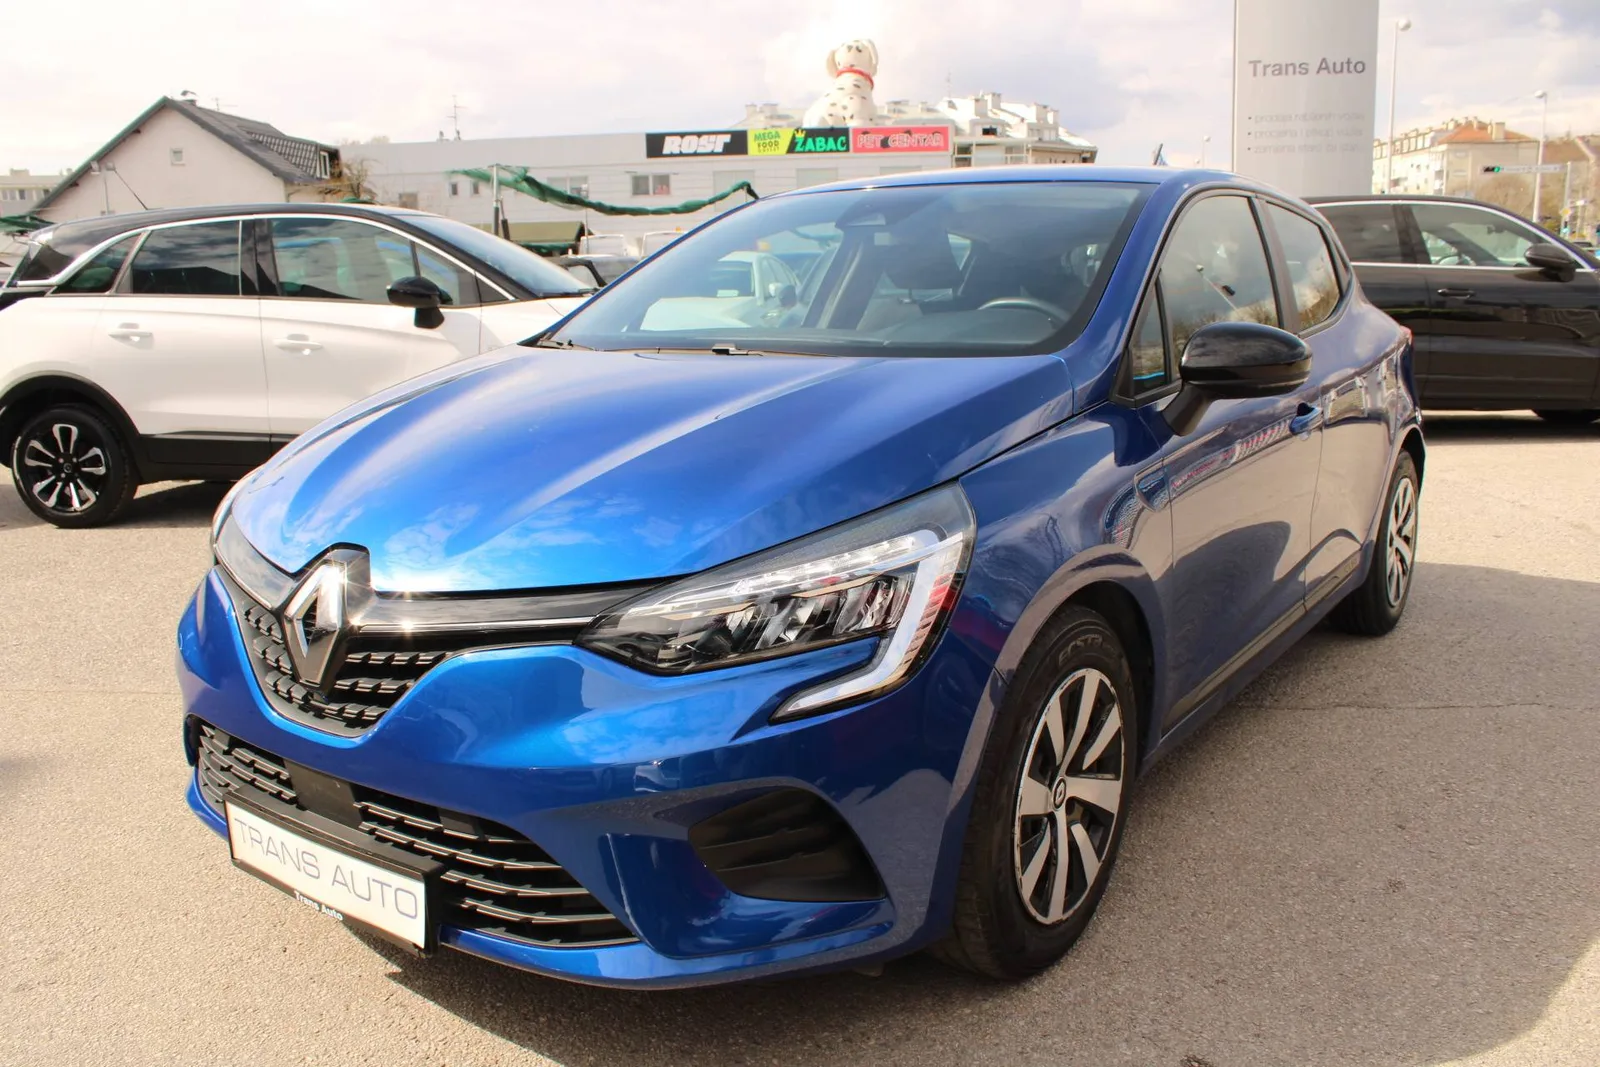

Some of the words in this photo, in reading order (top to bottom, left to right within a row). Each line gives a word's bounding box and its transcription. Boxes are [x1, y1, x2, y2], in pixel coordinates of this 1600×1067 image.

[1248, 59, 1309, 77] Trans
[1316, 57, 1366, 75] Auto
[662, 133, 732, 155] ROST
[754, 130, 781, 142] MEGA
[757, 140, 780, 149] FOOD
[857, 133, 883, 149] PET
[887, 132, 945, 148] CENTAR
[234, 817, 321, 880] TRANS
[331, 864, 418, 920] AUTO
[293, 889, 320, 911] Trans
[321, 903, 344, 921] Auto
